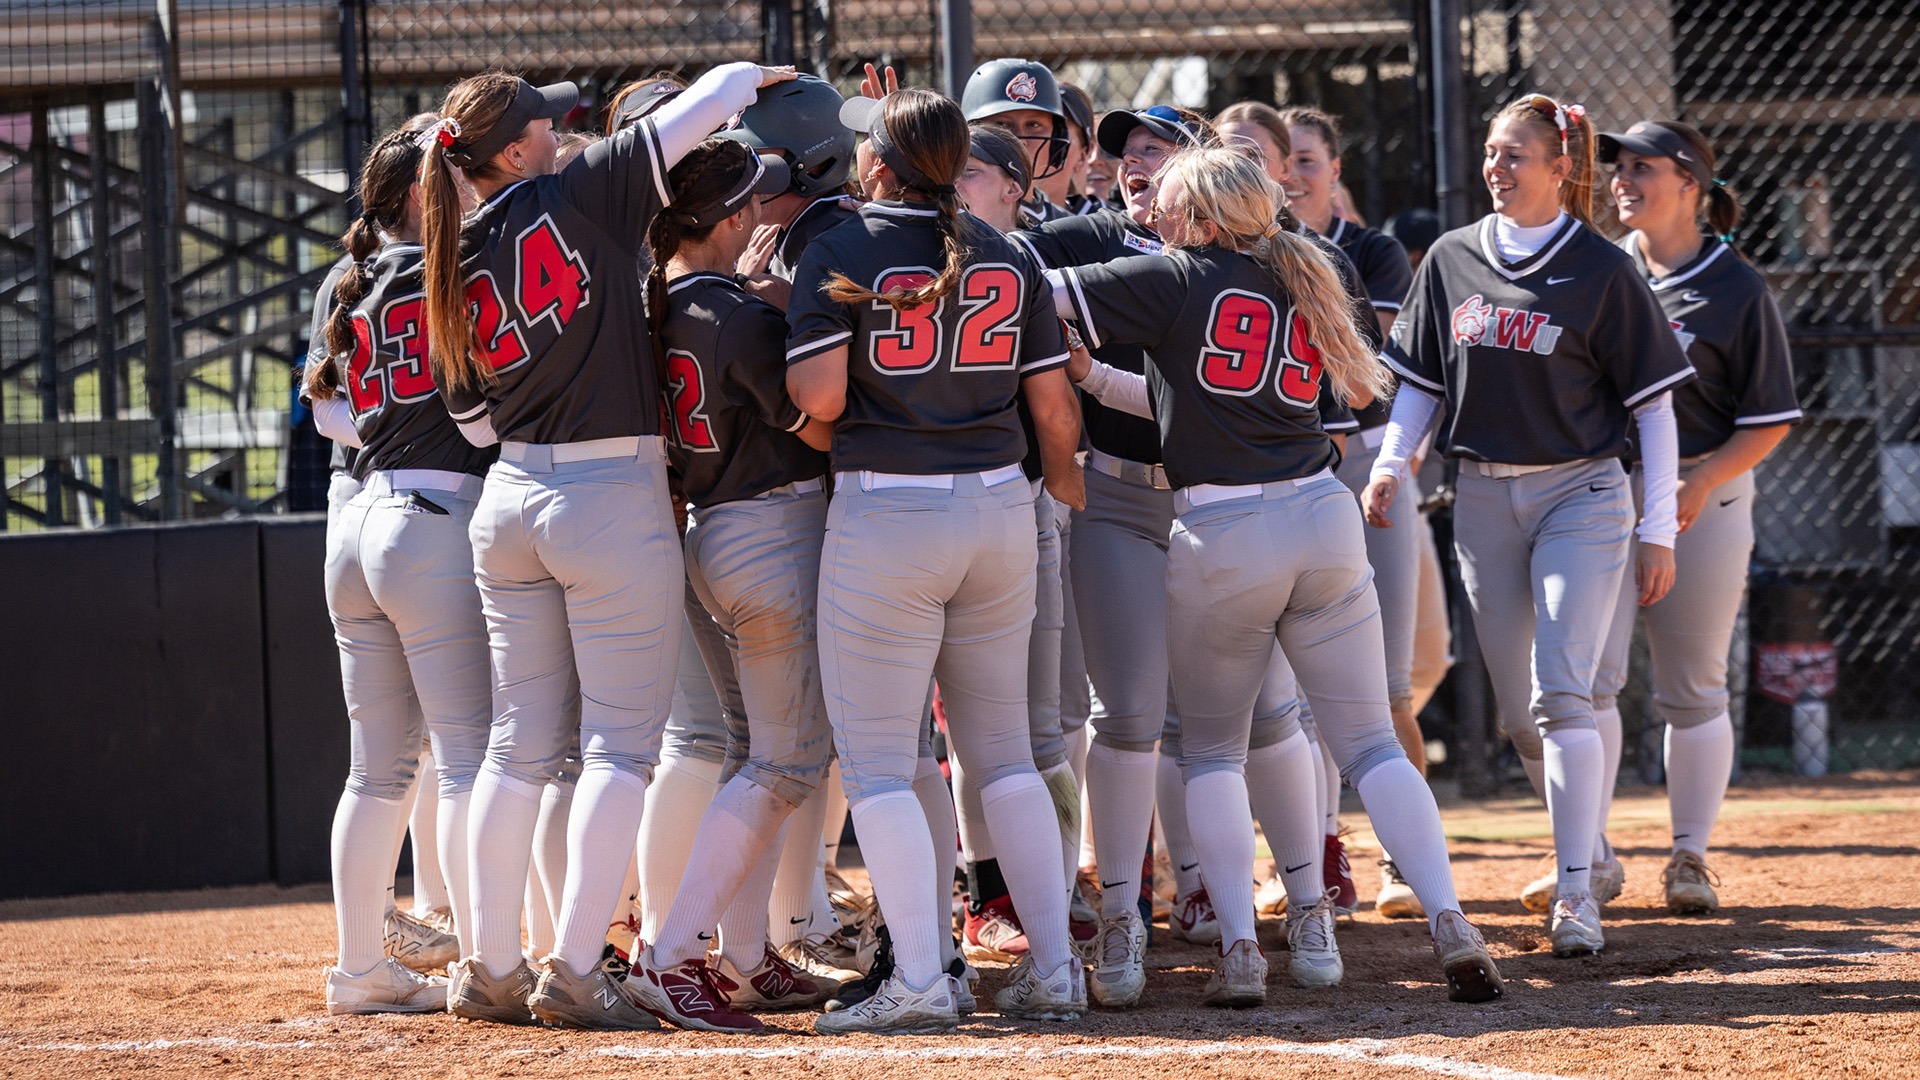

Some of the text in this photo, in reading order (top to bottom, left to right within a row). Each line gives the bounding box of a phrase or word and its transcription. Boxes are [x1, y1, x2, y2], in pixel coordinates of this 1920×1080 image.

[463, 212, 591, 377] 24
[868, 262, 1025, 376] 32
[1196, 287, 1324, 409] 99
[1481, 307, 1564, 355] IWU
[345, 291, 439, 421] 23
